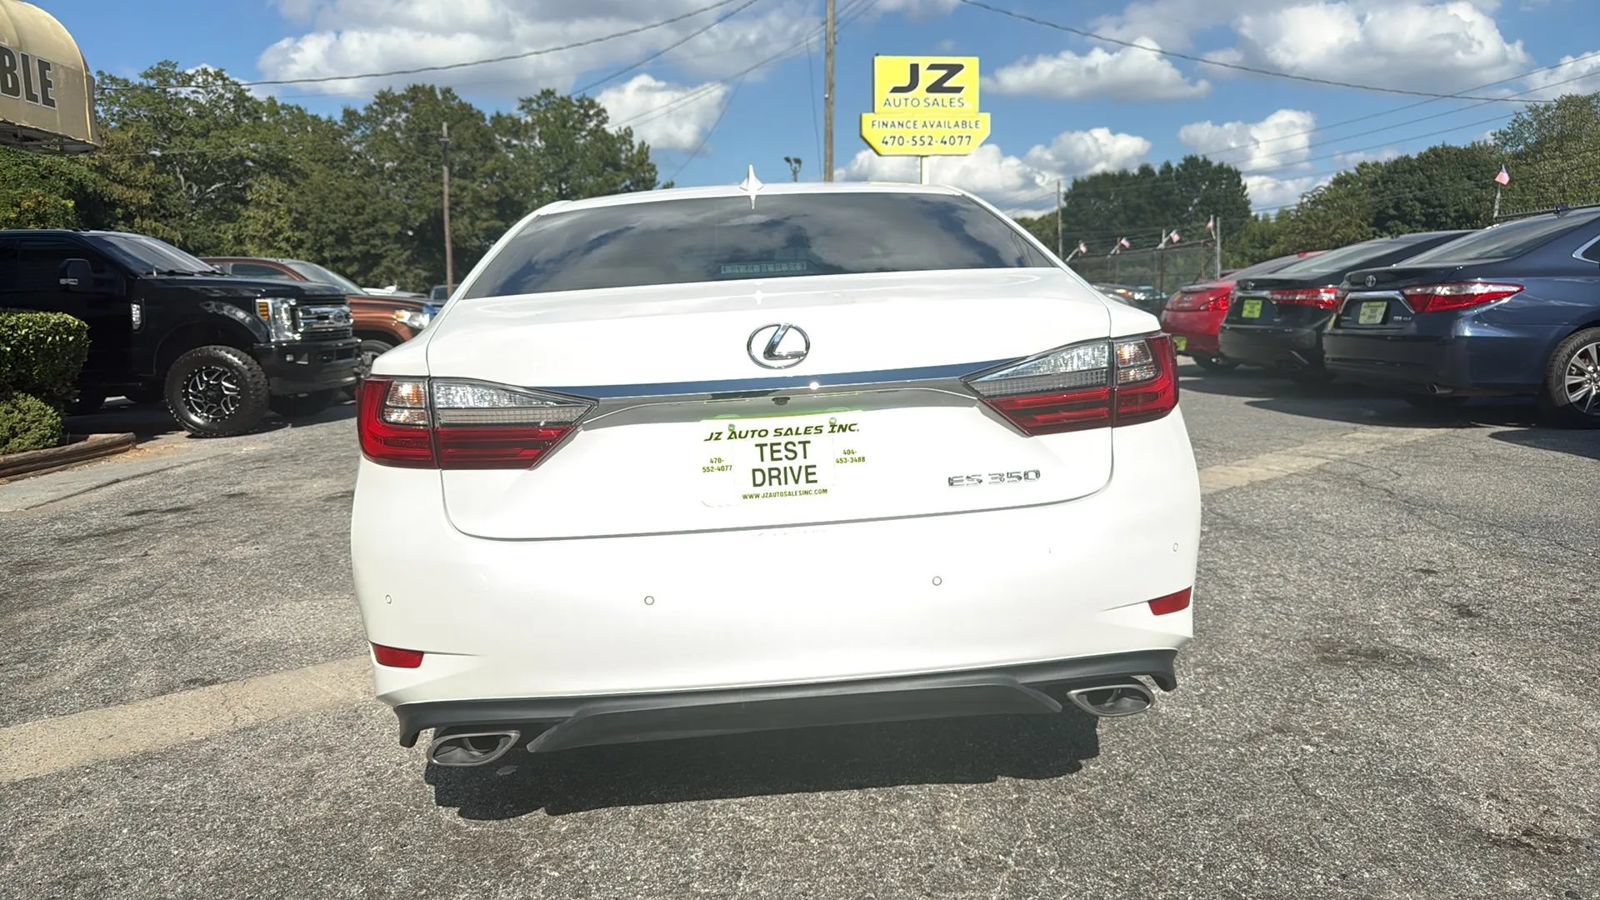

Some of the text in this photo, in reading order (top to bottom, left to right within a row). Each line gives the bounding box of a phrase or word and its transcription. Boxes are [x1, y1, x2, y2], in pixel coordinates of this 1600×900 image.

[0, 45, 56, 109] BLE
[889, 63, 965, 93] JZ
[883, 97, 965, 108] AUTO SALES
[871, 120, 980, 130] FINANCE AVAILABLE
[881, 135, 972, 146] 470-552-4077
[703, 423, 860, 442] JZ AUTO SALES INC.
[755, 440, 811, 462] TEST
[752, 465, 818, 487] DRIVE
[947, 469, 1041, 487] ES 350
